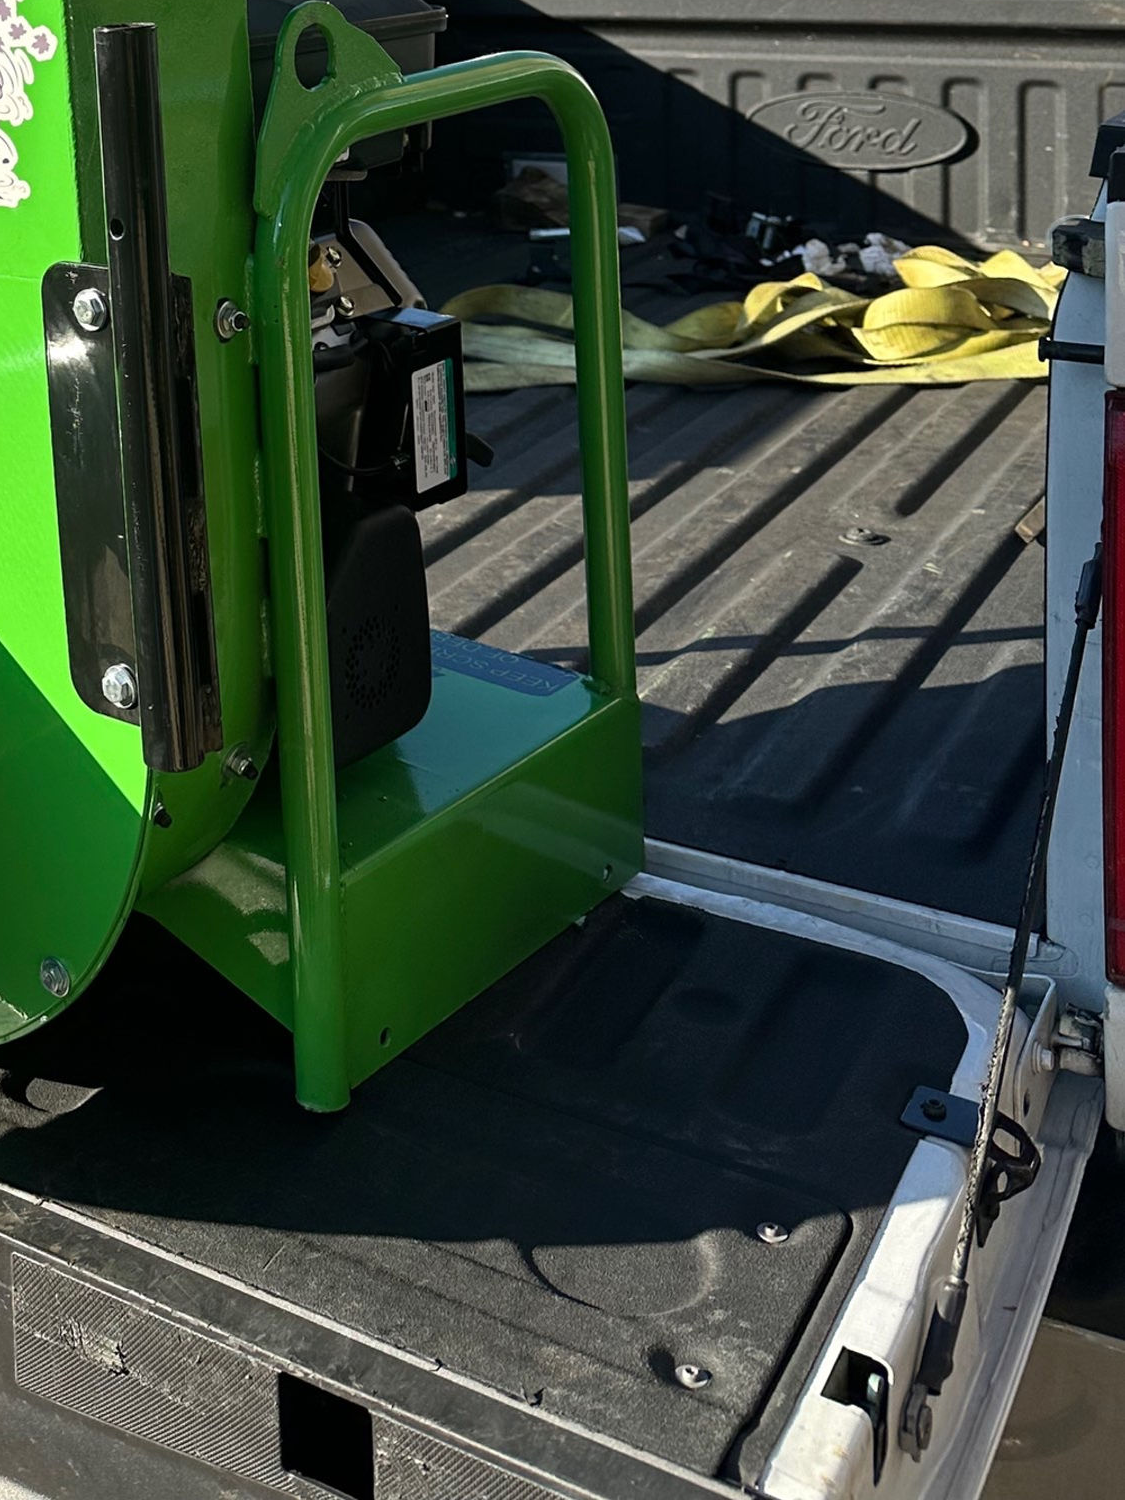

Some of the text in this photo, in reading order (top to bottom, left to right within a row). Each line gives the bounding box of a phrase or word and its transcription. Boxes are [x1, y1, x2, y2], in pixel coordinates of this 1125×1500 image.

[783, 100, 923, 157] Ford
[490, 651, 519, 663] OF
[490, 668, 560, 692] KEEP
